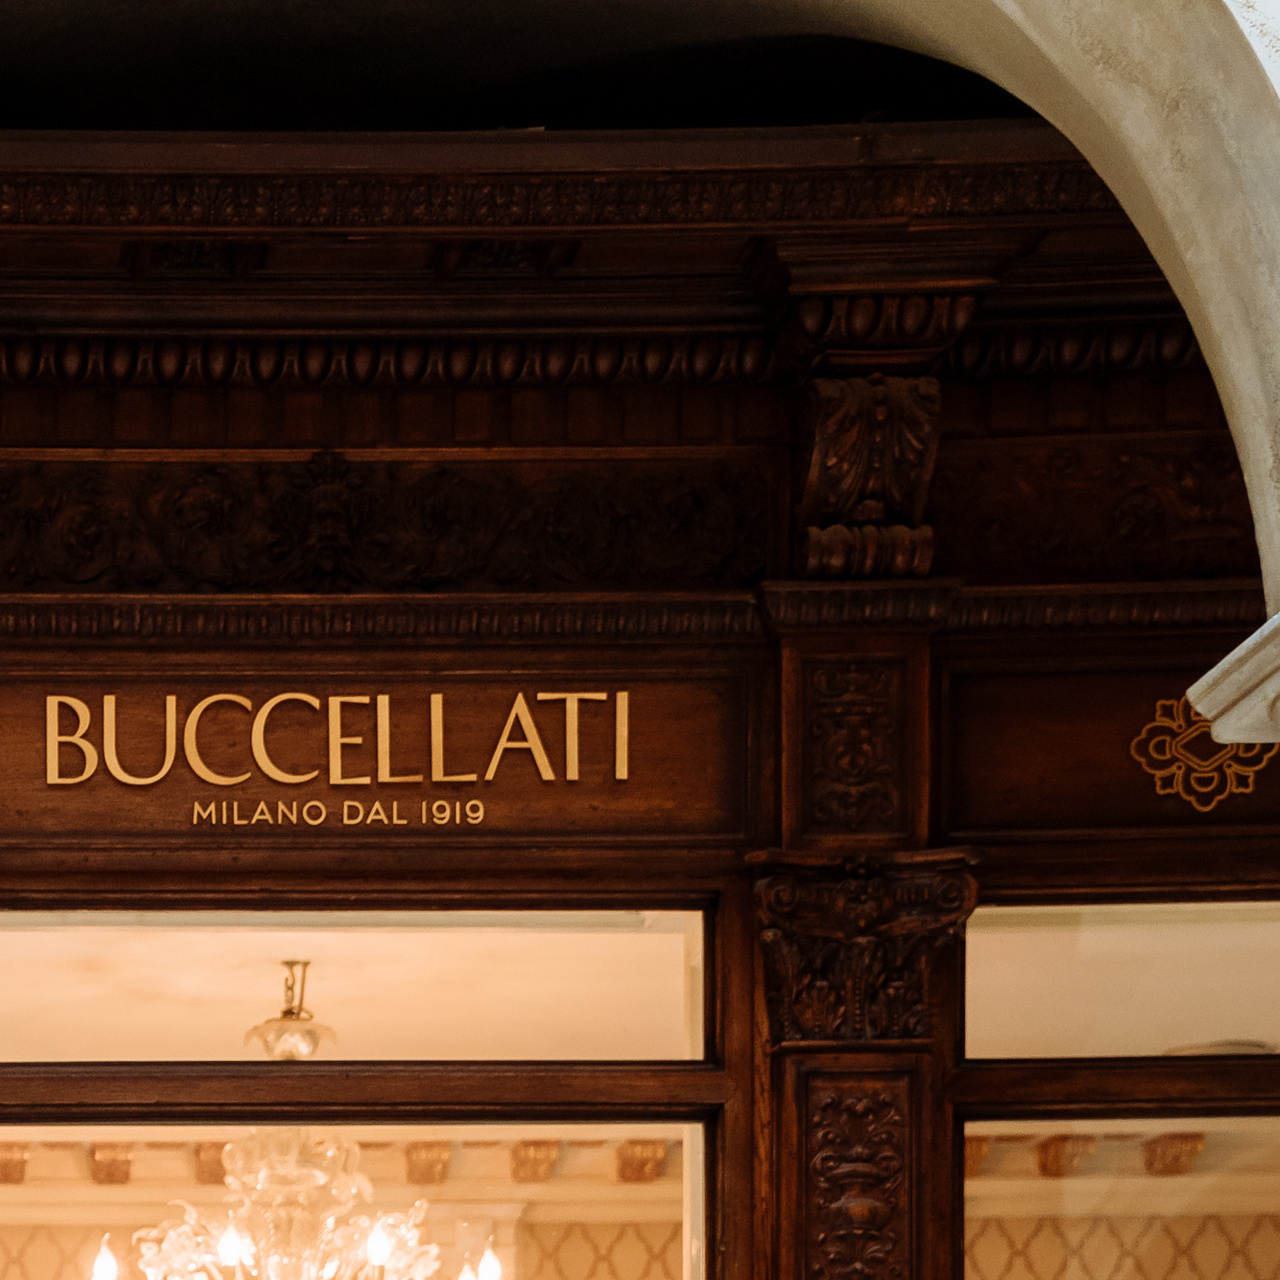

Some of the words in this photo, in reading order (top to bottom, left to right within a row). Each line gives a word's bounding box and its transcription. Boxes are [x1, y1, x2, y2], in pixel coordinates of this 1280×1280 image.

[46, 691, 629, 785] BUCCELLATI
[192, 800, 327, 826] MILANO
[342, 800, 408, 825] DAL
[421, 799, 485, 825] 1919
